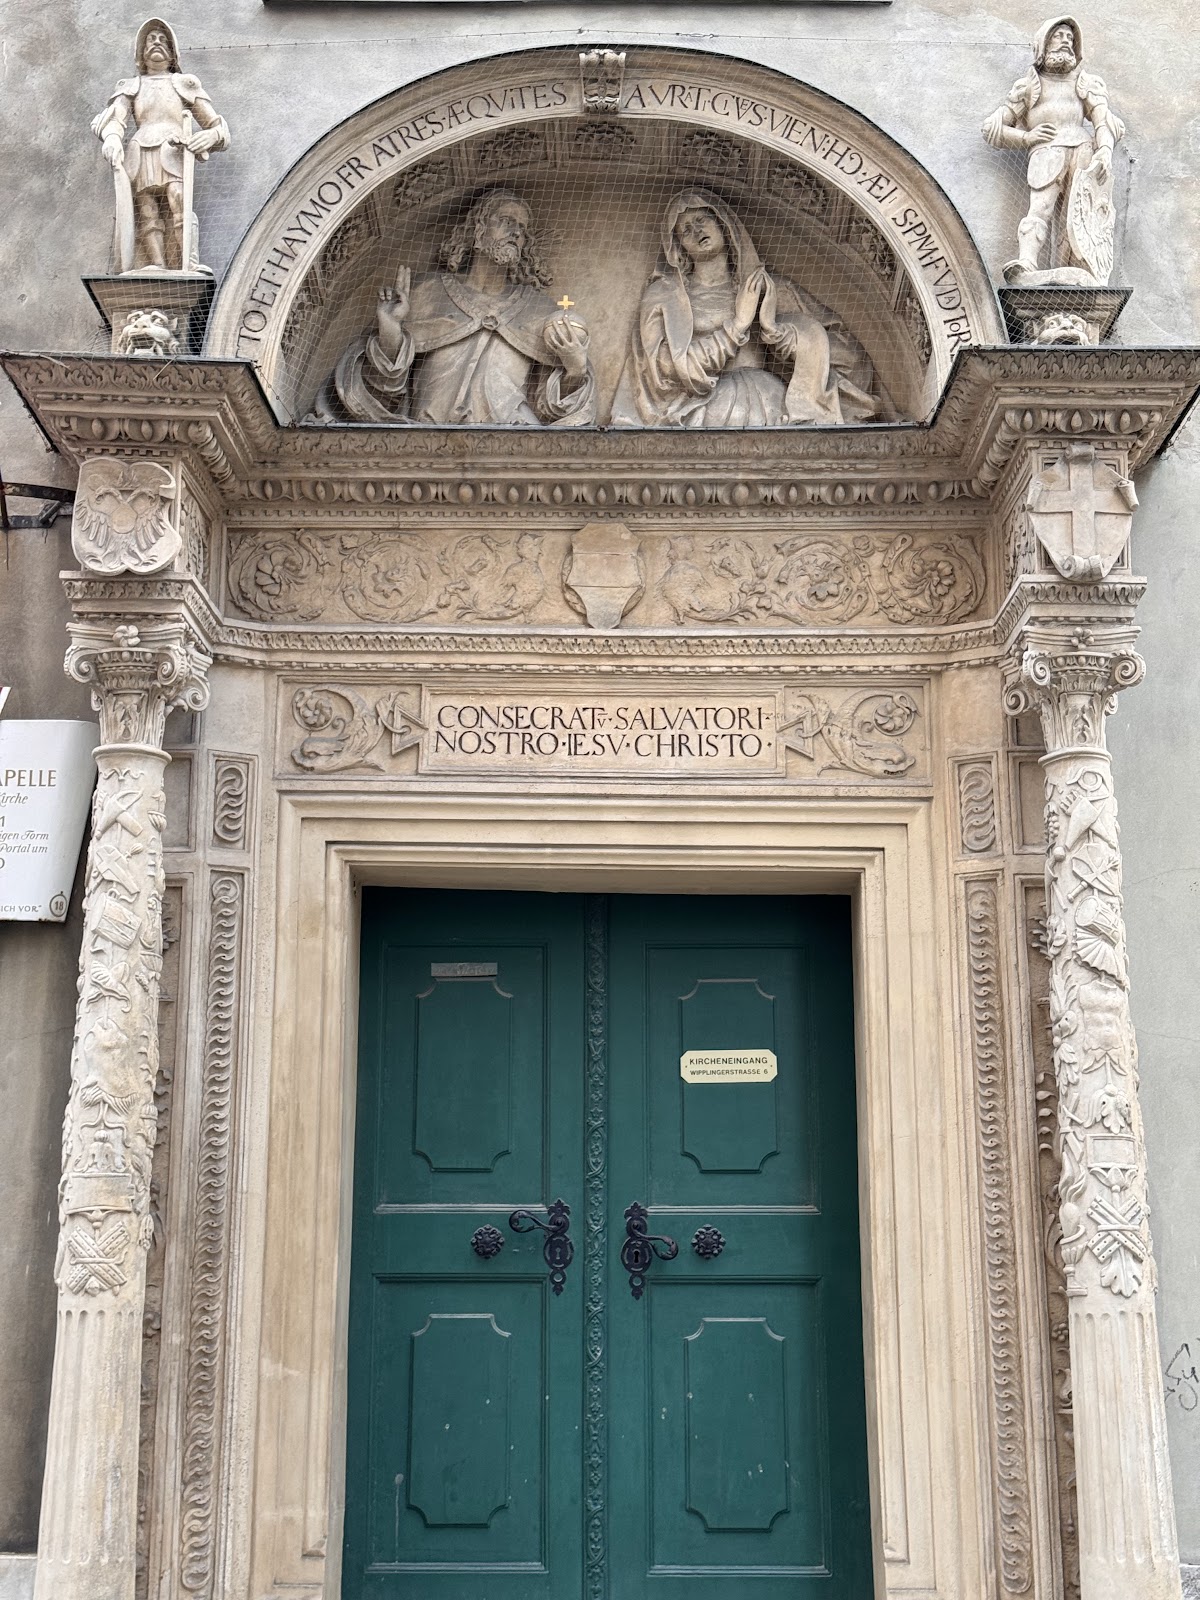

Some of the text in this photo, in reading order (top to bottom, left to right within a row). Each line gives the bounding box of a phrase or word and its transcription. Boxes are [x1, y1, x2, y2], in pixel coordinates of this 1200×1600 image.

[434, 730, 559, 755] NOSTRO
[634, 733, 763, 758] CHRISTO
[54, 900, 64, 912] 18
[689, 1057, 768, 1066] KIRCHENEINGANG
[690, 1068, 761, 1076] WIPPLINGERSTRASSE
